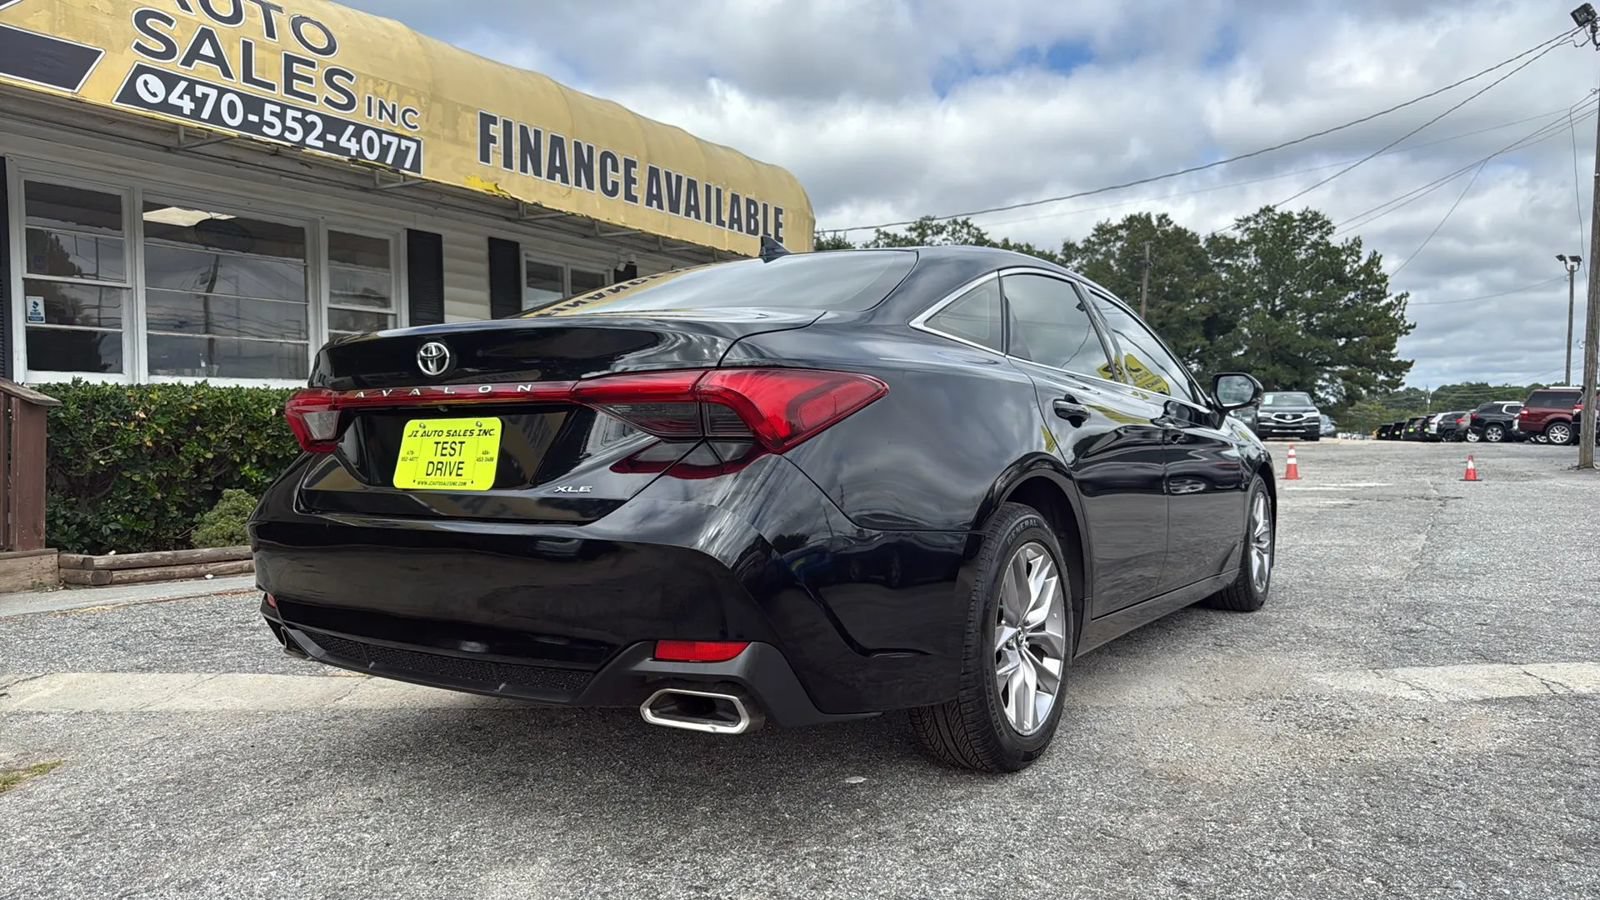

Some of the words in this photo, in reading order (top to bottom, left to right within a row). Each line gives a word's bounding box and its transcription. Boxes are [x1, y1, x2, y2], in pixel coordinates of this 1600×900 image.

[132, 9, 357, 111] SALES
[364, 95, 421, 132] INC
[168, 81, 417, 169] 470-552-4077
[478, 111, 639, 204] FINANCE
[645, 163, 786, 244] AVAILABLE
[355, 384, 532, 398] AVALON
[407, 430, 419, 438] JZ
[420, 430, 444, 438] AUTO
[445, 429, 475, 437] SALES
[433, 441, 466, 457] TEST
[425, 461, 465, 477] DRIVE
[554, 485, 593, 494] XLE
[1006, 519, 1039, 545] GENERAL
